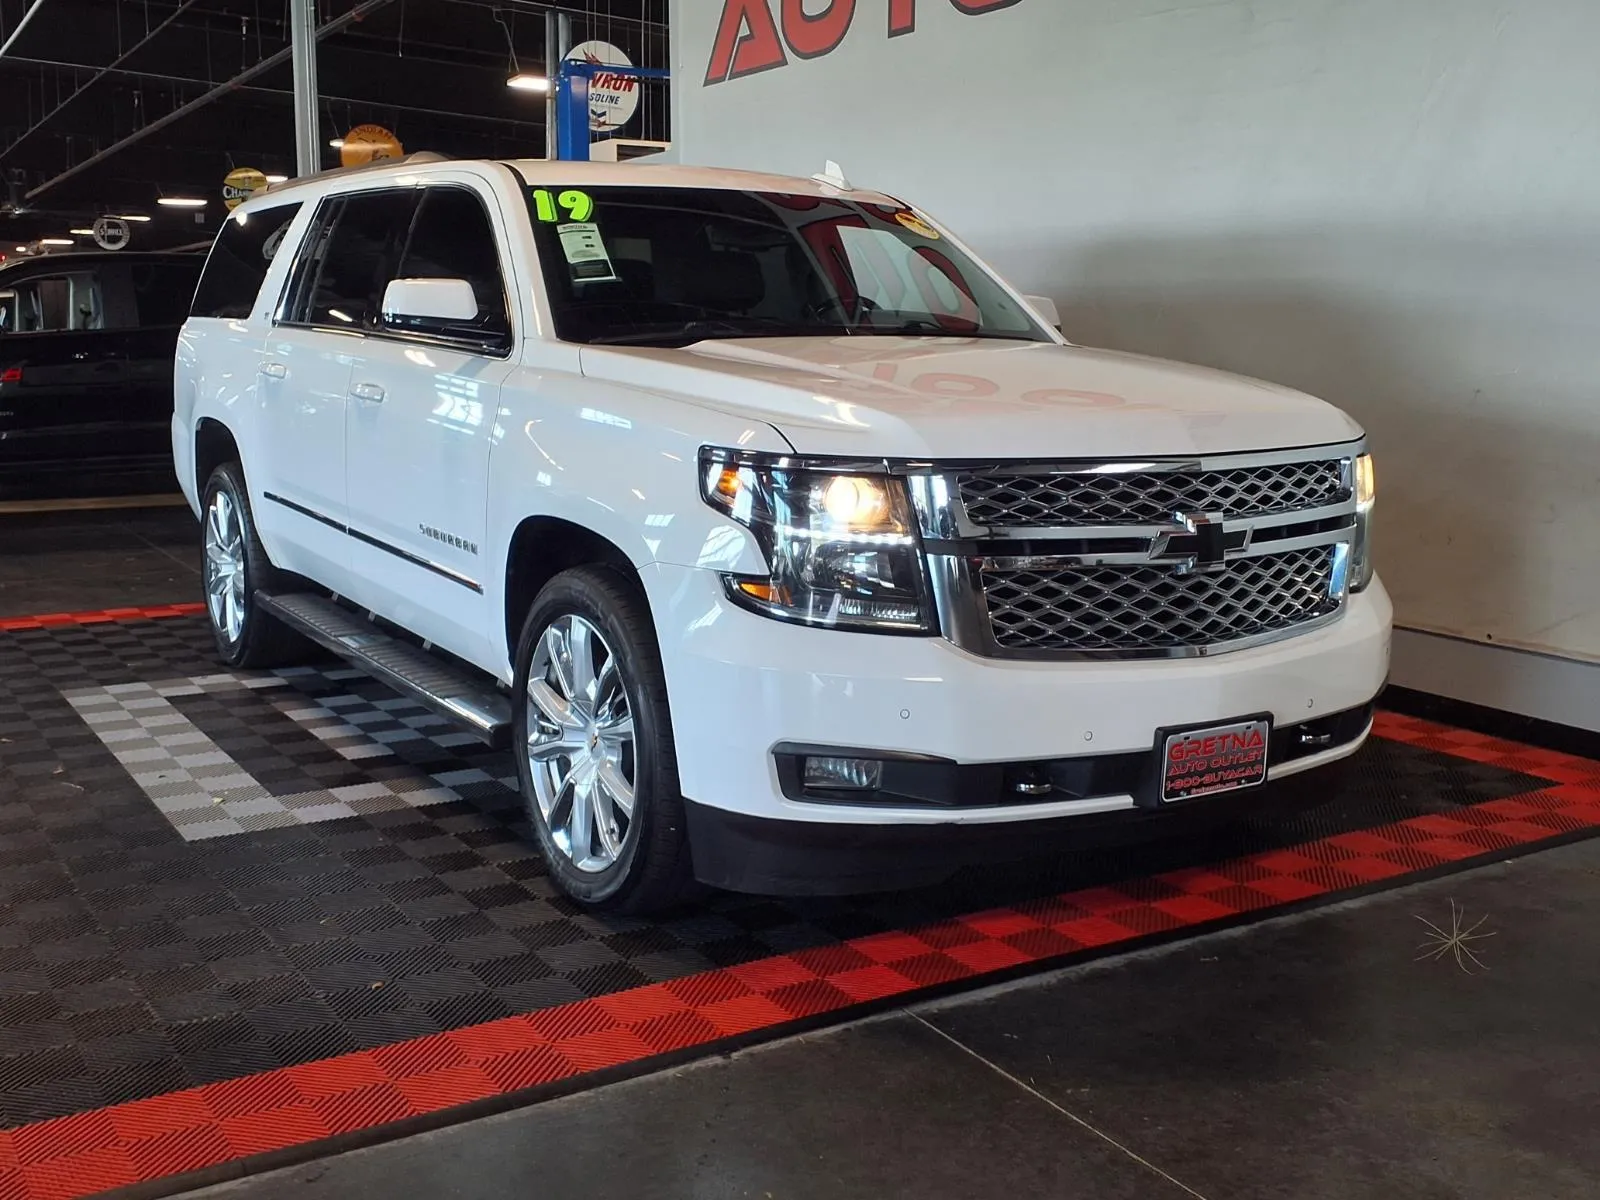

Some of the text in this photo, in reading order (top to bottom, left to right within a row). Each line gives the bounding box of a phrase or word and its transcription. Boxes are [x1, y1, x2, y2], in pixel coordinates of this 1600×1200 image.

[703, 0, 1024, 87] AU
[590, 72, 635, 92] VRON
[589, 93, 620, 105] SOLINE
[533, 190, 593, 222] 19
[419, 523, 478, 556] SUBURBAN
[1169, 730, 1264, 761] GRETNA
[1169, 749, 1264, 776] AUTO OUTLET
